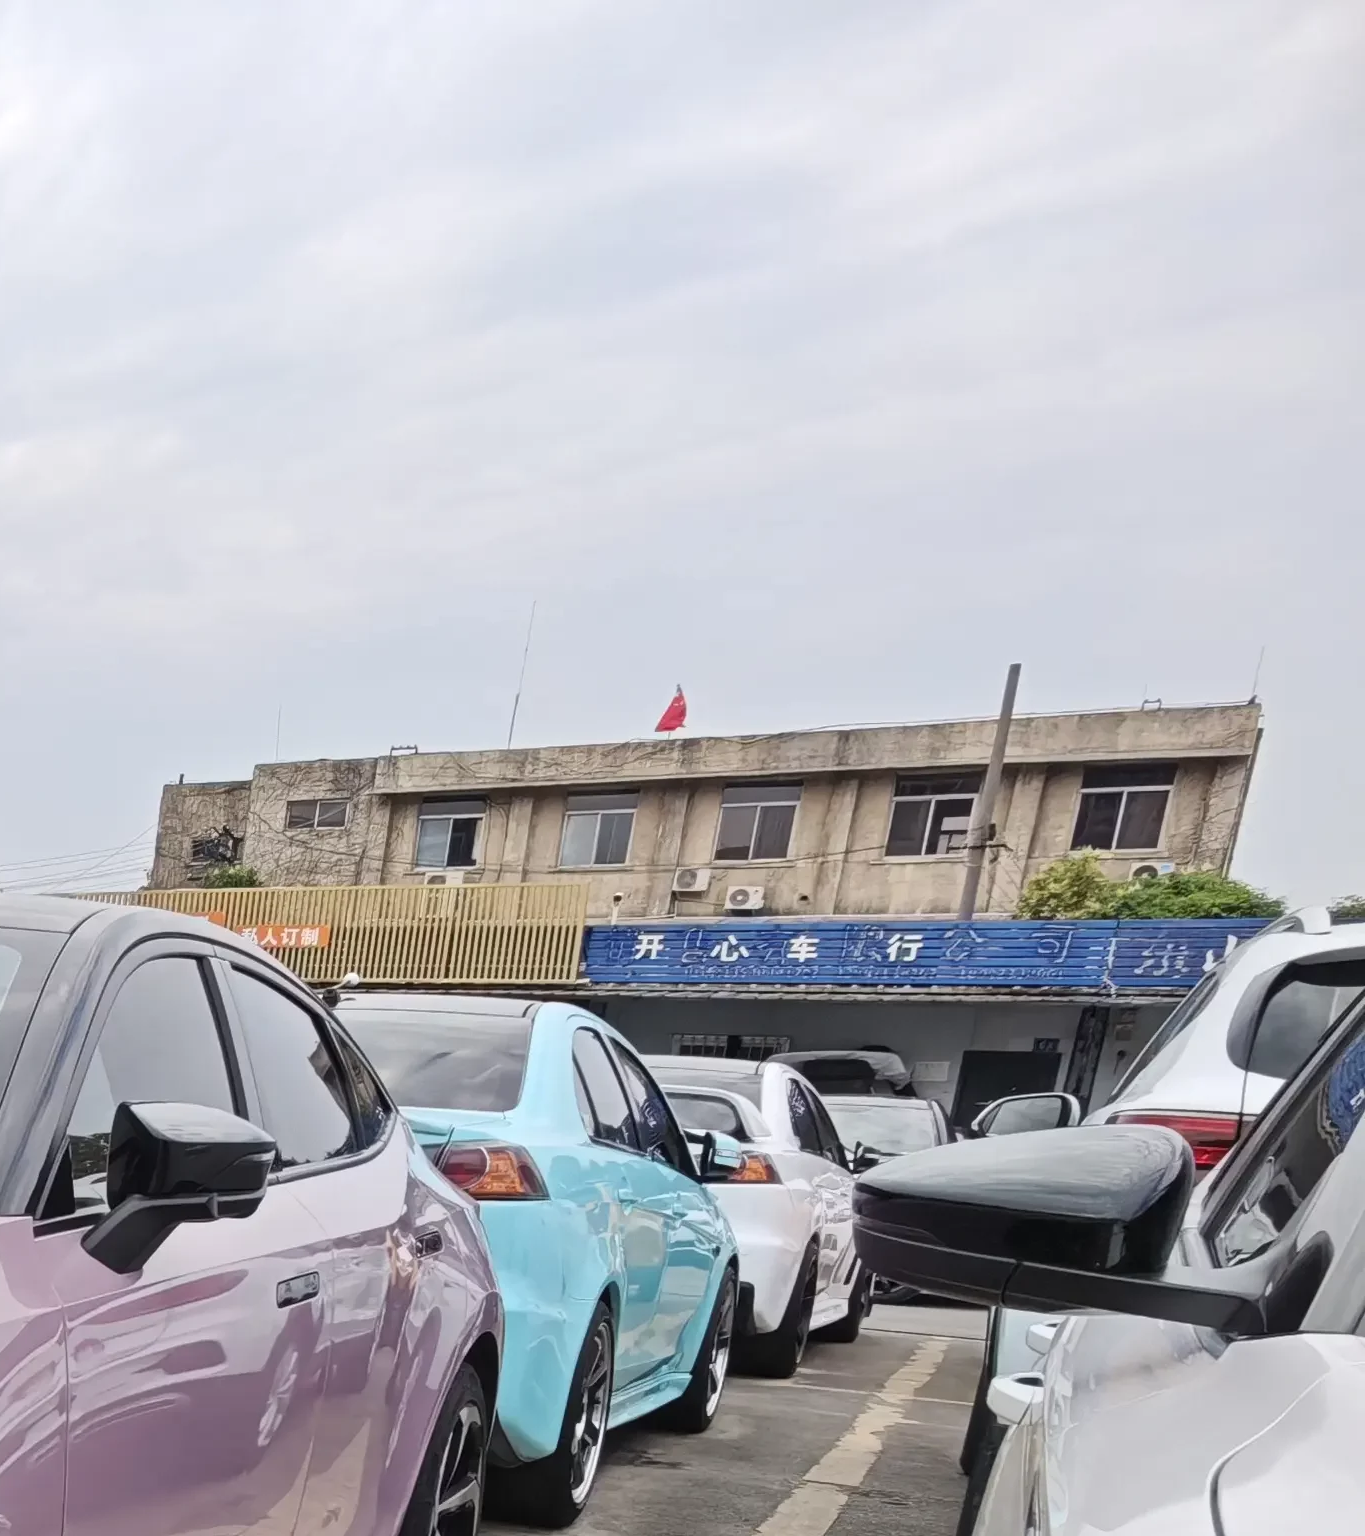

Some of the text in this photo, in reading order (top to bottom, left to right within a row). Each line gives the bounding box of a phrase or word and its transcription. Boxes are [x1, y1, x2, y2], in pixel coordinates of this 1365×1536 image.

[240, 927, 320, 946] 私人订制
[634, 934, 925, 963] 开心车行
